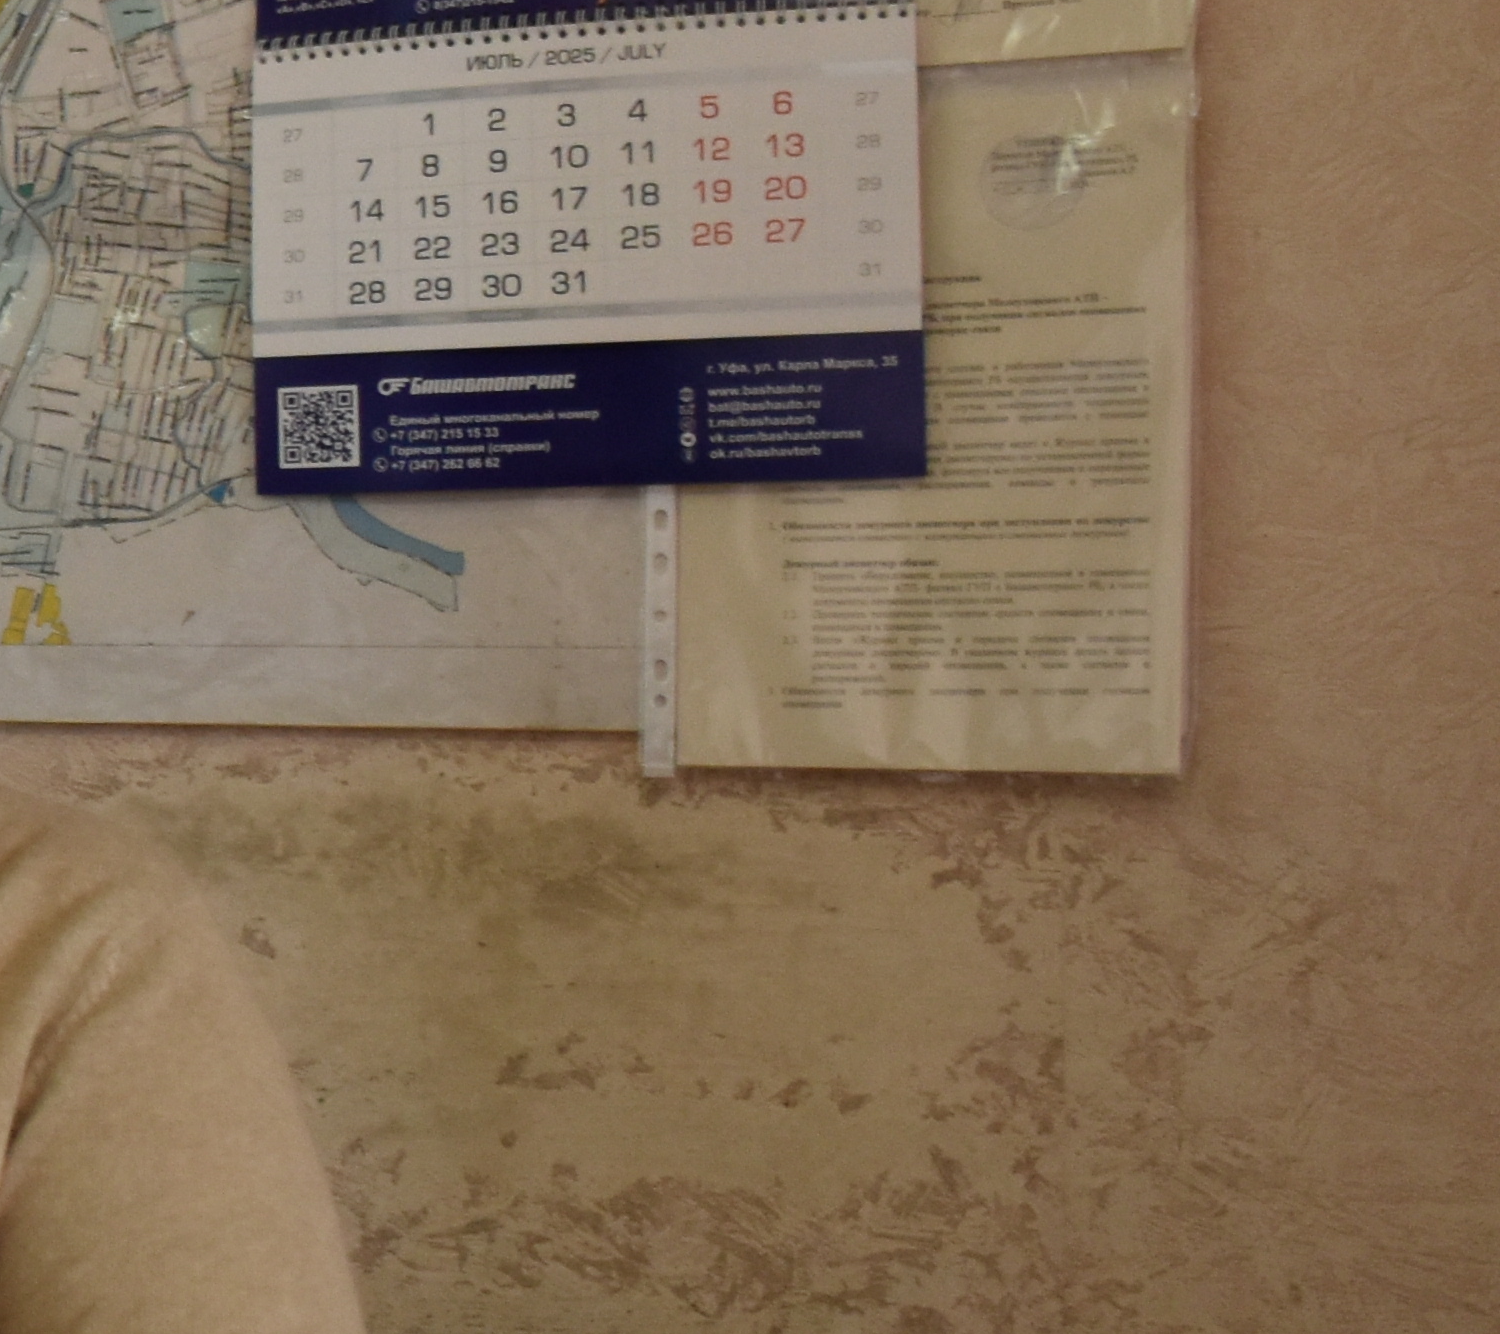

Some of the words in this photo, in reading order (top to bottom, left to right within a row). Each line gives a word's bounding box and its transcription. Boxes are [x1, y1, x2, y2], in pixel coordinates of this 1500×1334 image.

[465, 52, 525, 72] ИЮЛЬ
[544, 46, 597, 66] 2025
[616, 42, 668, 62] JULY
[422, 111, 435, 136] 1
[487, 107, 507, 132] 2
[556, 102, 577, 128] 3
[627, 98, 649, 122] 4
[699, 94, 720, 120] 5
[772, 90, 794, 116] 6
[356, 157, 374, 182] 7
[420, 153, 440, 178] 8
[488, 148, 508, 174] 9
[550, 143, 590, 169] 10
[620, 139, 655, 166] 11
[693, 135, 731, 162] 12
[765, 132, 806, 158] 13
[350, 197, 385, 223] 14
[414, 193, 451, 219] 15
[482, 189, 519, 215] 16
[551, 185, 588, 211] 17
[621, 181, 661, 208] 18
[693, 178, 733, 204] 19
[764, 174, 809, 202] 20
[348, 239, 381, 265] 21
[413, 235, 452, 261] 22
[480, 231, 521, 257] 23
[549, 227, 591, 254] 24
[620, 223, 662, 250] 25
[691, 220, 734, 247] 26
[765, 217, 807, 244] 27
[348, 279, 387, 306] 28
[414, 276, 453, 302] 29
[481, 272, 523, 299] 30
[550, 269, 587, 296] 31
[707, 384, 823, 397] www.bashauto.ru
[389, 414, 441, 426] Единый
[389, 429, 405, 440] +7
[408, 428, 439, 442] (347)
